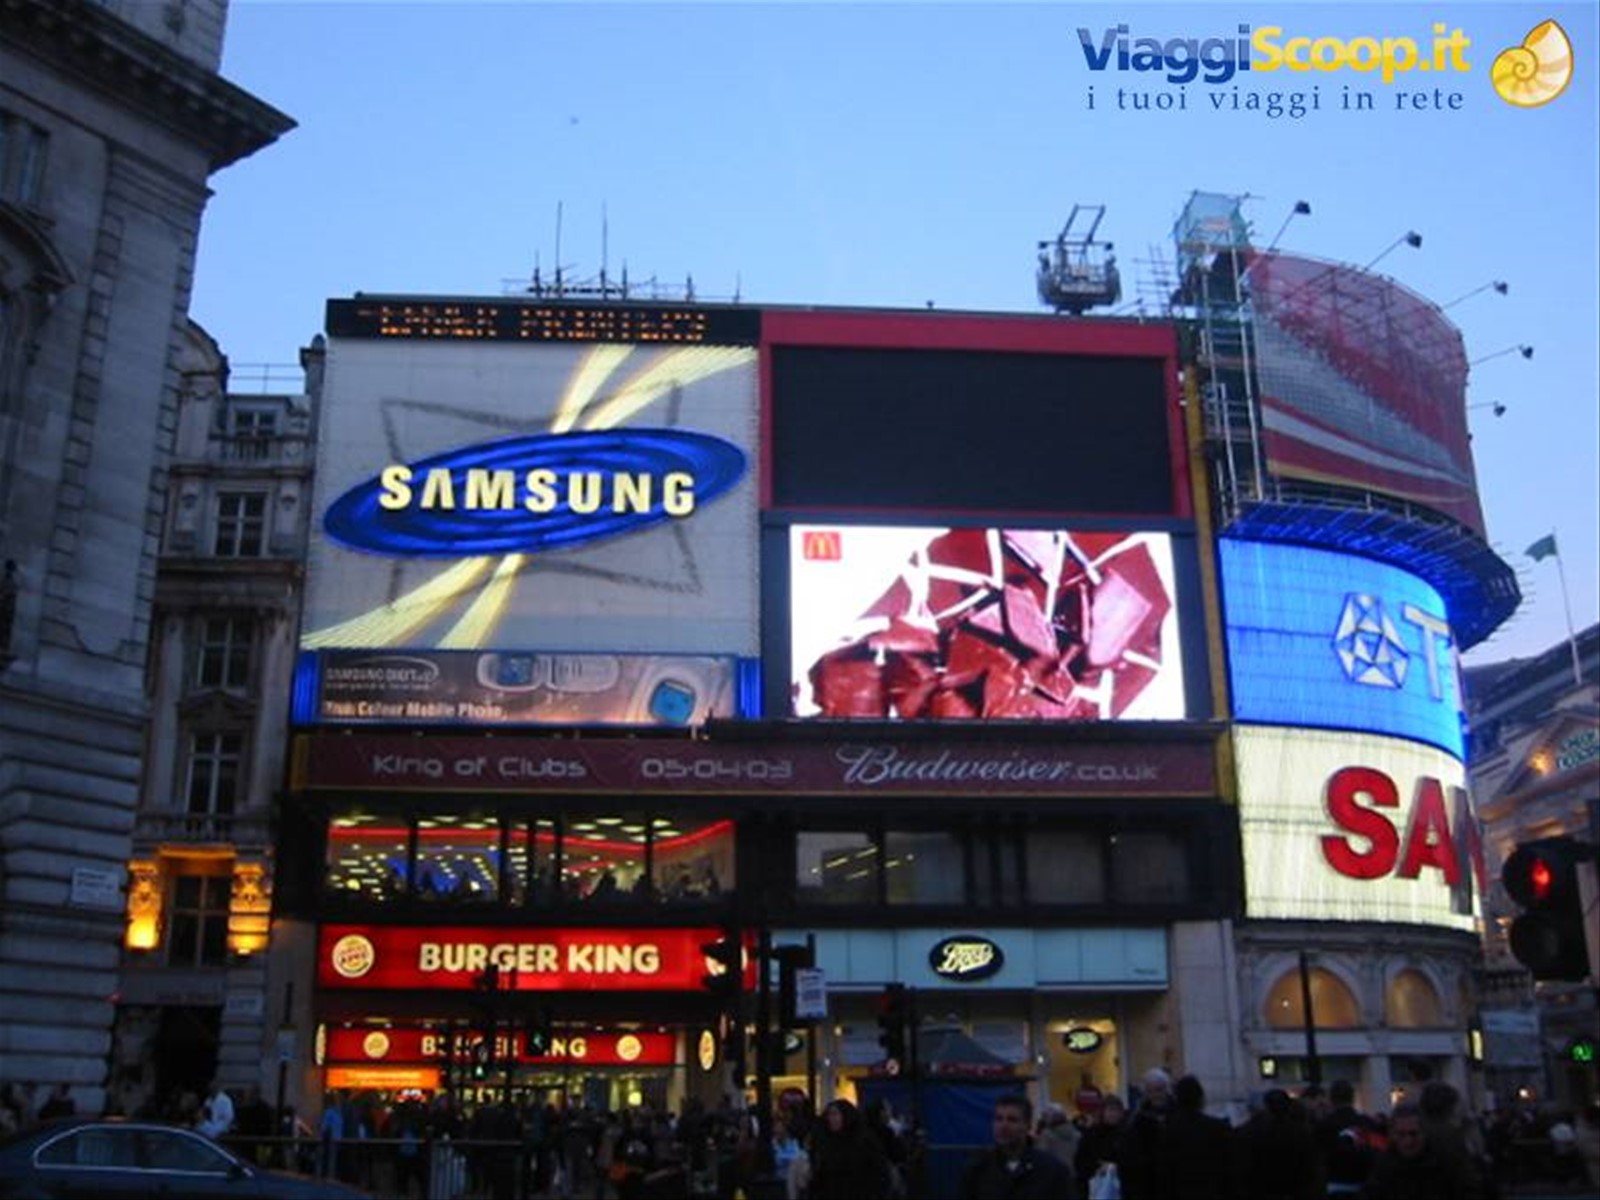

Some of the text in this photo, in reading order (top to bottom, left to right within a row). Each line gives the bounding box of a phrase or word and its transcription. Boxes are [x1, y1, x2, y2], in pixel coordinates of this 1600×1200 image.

[377, 465, 695, 515] SAMSUNG
[372, 754, 443, 778] King
[454, 755, 488, 776] of
[499, 756, 586, 777] Clubs
[419, 943, 660, 974] BURGER KING
[936, 942, 994, 974] Boots
